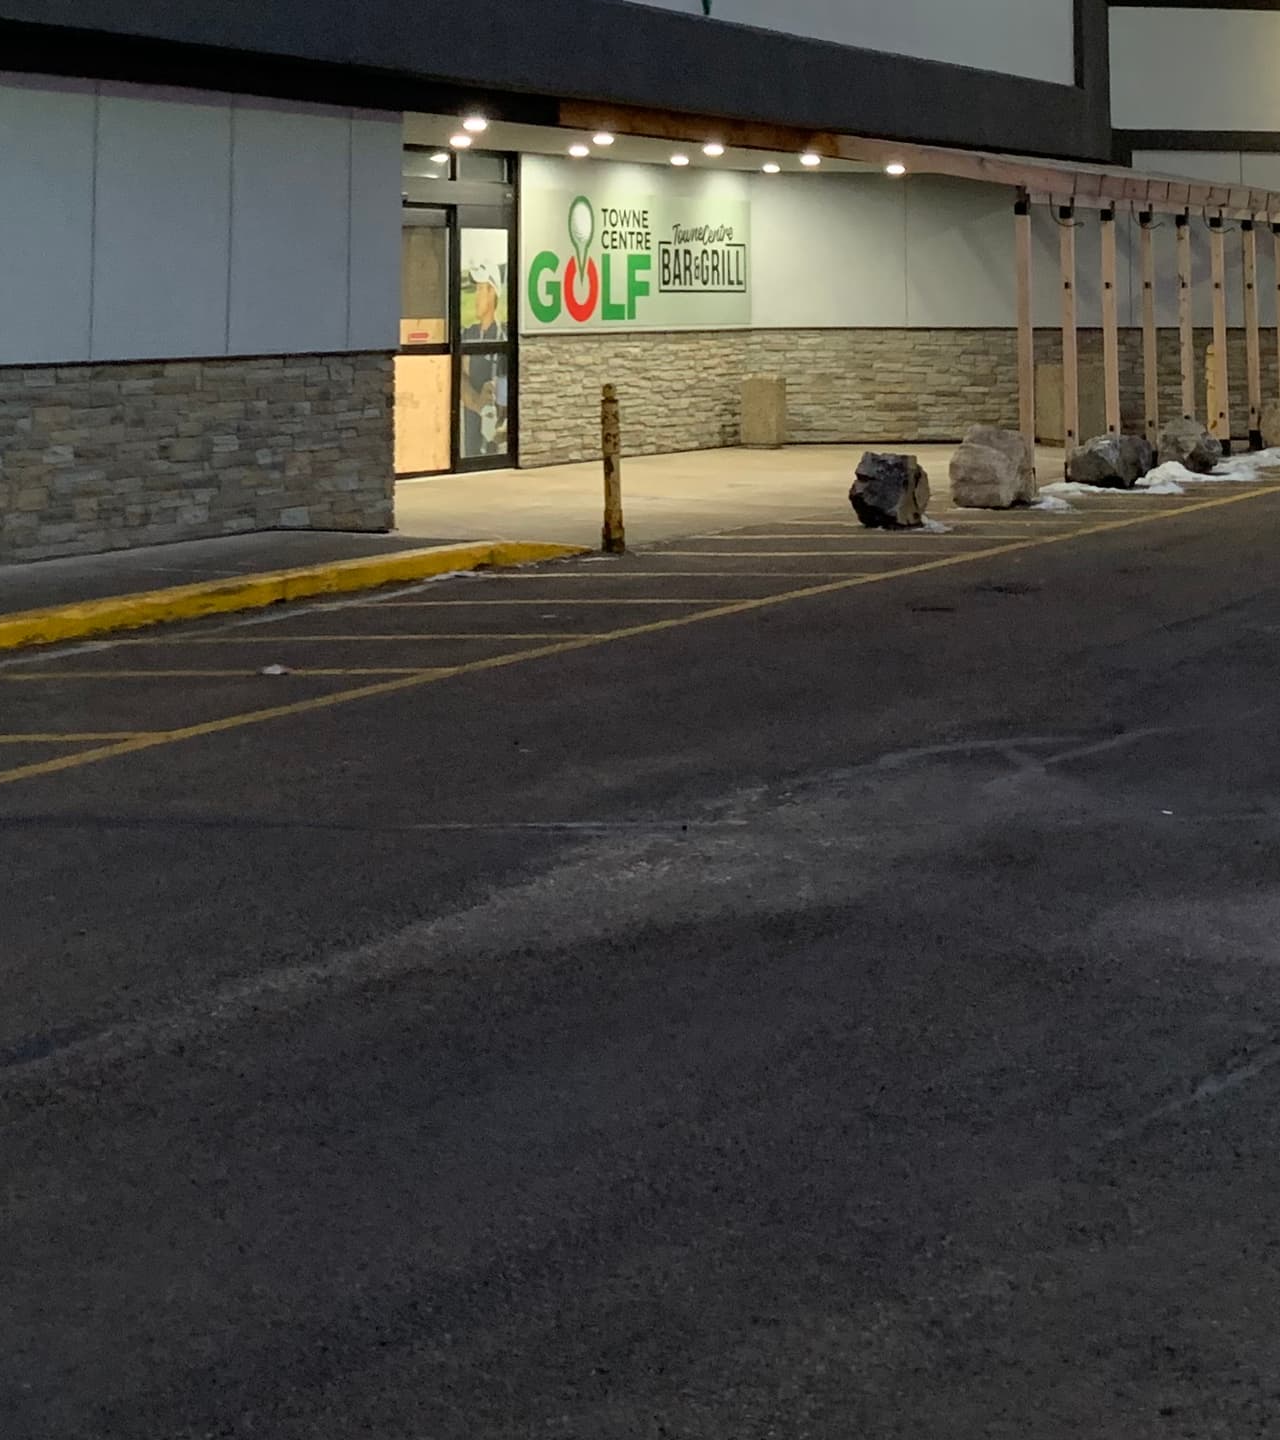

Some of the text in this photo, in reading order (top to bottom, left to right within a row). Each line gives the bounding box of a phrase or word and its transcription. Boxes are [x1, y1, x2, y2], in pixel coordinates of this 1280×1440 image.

[601, 208, 649, 228] TOWNE
[601, 230, 651, 250] CENTRE
[528, 250, 651, 324] GOLF
